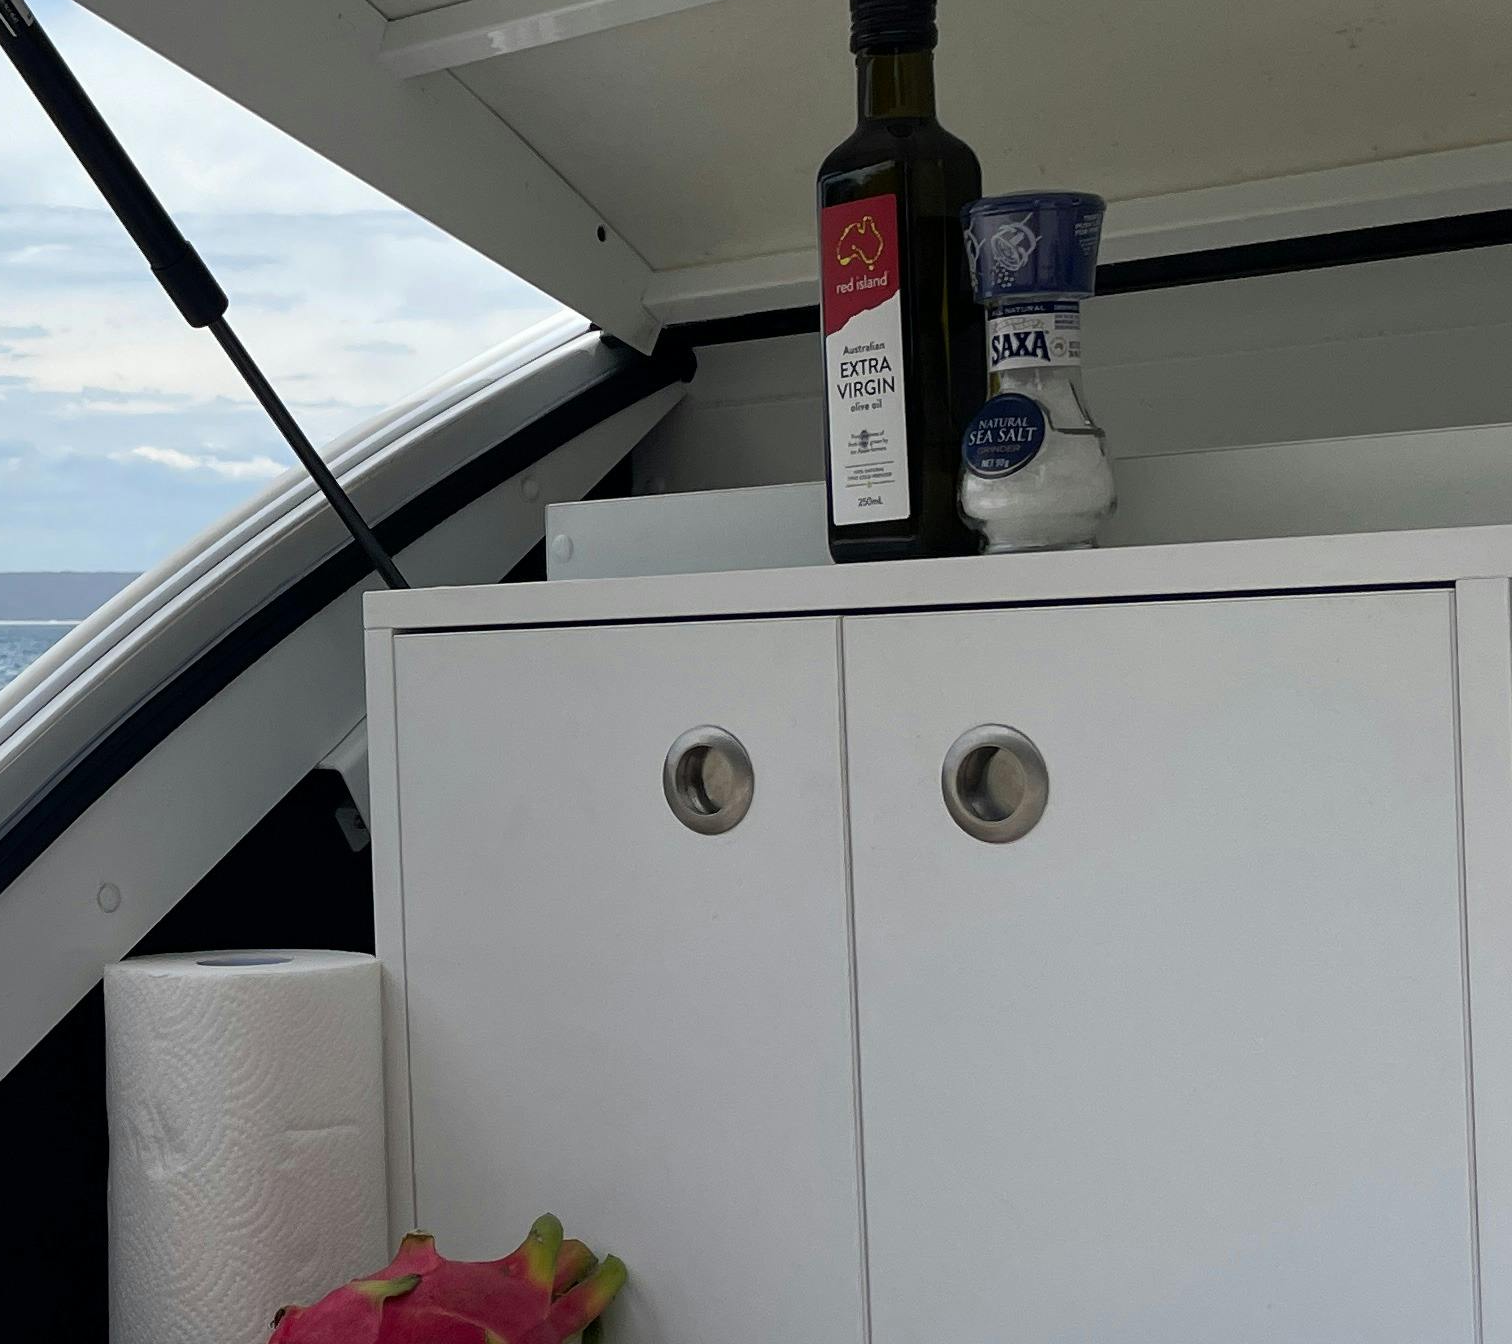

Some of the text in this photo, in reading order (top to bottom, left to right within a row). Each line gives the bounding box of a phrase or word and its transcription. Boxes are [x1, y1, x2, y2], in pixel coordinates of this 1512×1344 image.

[836, 271, 888, 294] red island
[843, 341, 886, 356] Australian
[992, 331, 1051, 367] SAXA
[840, 356, 892, 379] EXTRA
[837, 376, 895, 400] VIRGIN
[850, 398, 883, 412] olive oil
[978, 417, 1029, 430] NATURAL
[968, 427, 1038, 446] SEA SALT
